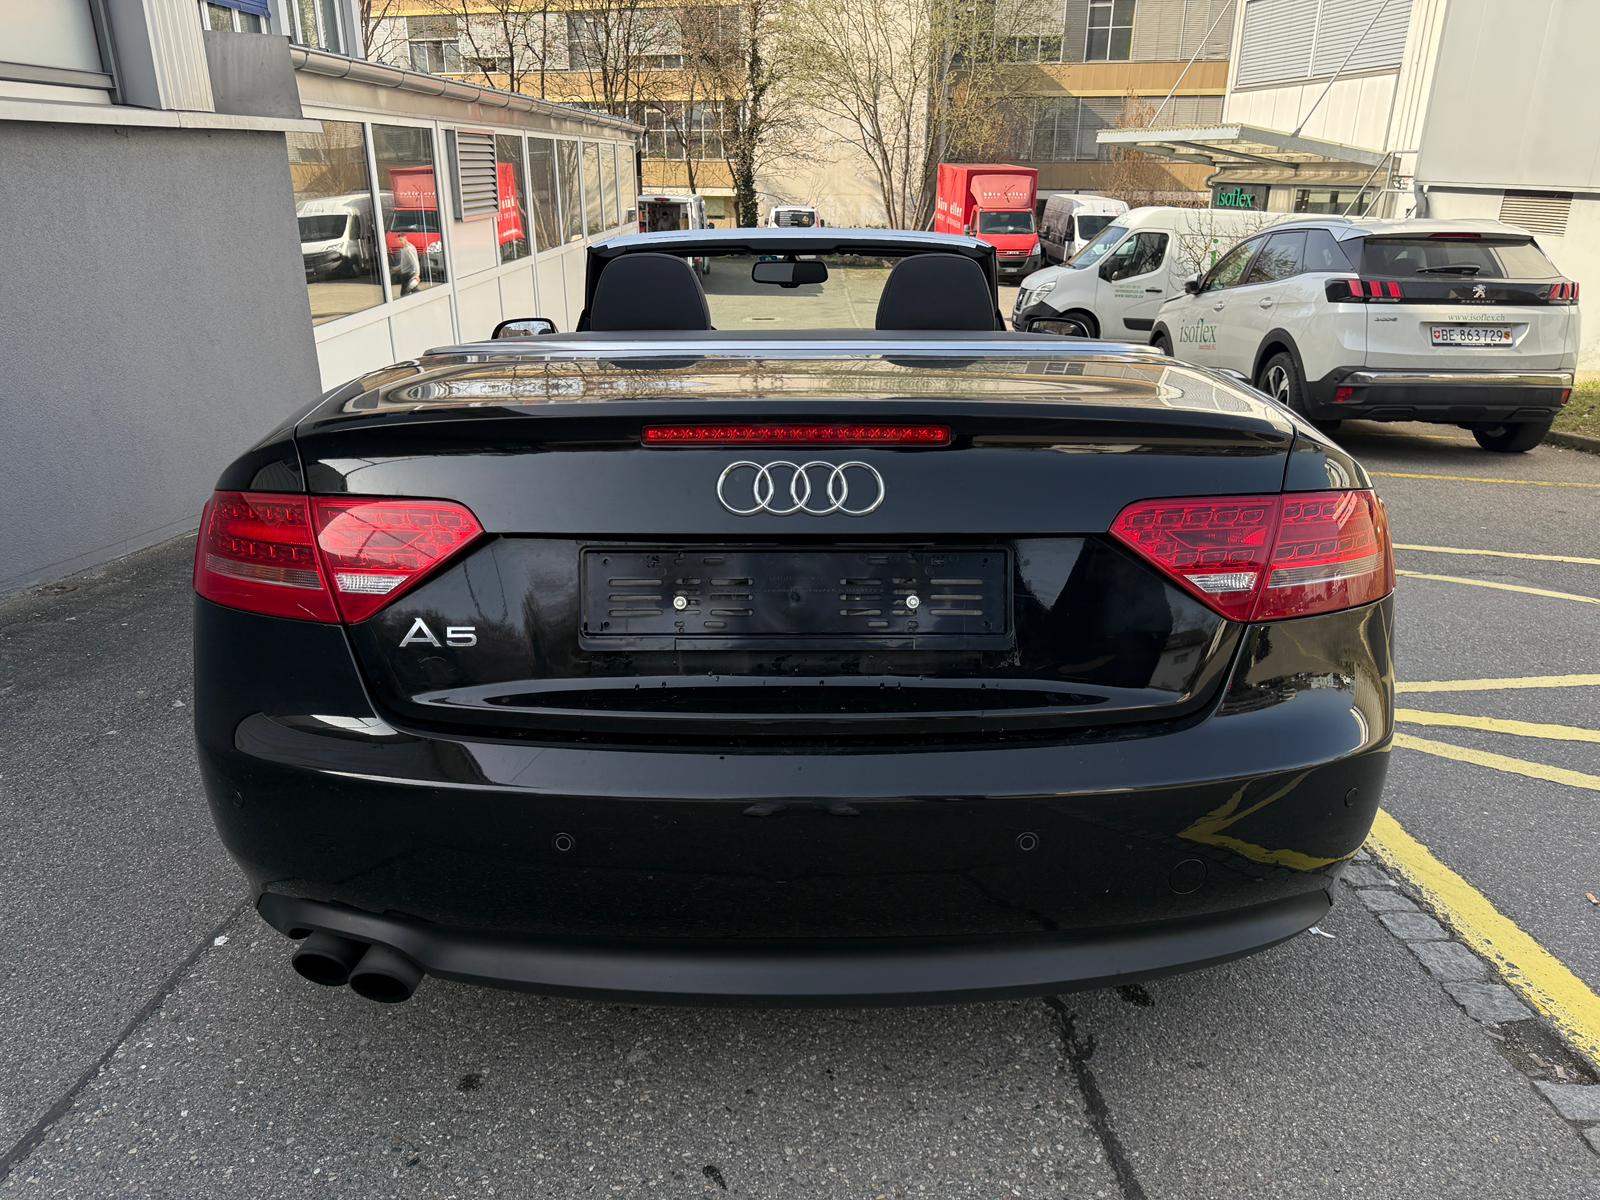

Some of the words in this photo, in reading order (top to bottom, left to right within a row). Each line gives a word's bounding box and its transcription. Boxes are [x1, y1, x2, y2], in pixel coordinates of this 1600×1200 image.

[1217, 185, 1254, 208] isoflex
[1447, 312, 1506, 323] www.isoflex.ch
[1179, 317, 1217, 343] isoflex
[398, 617, 479, 648] A5
